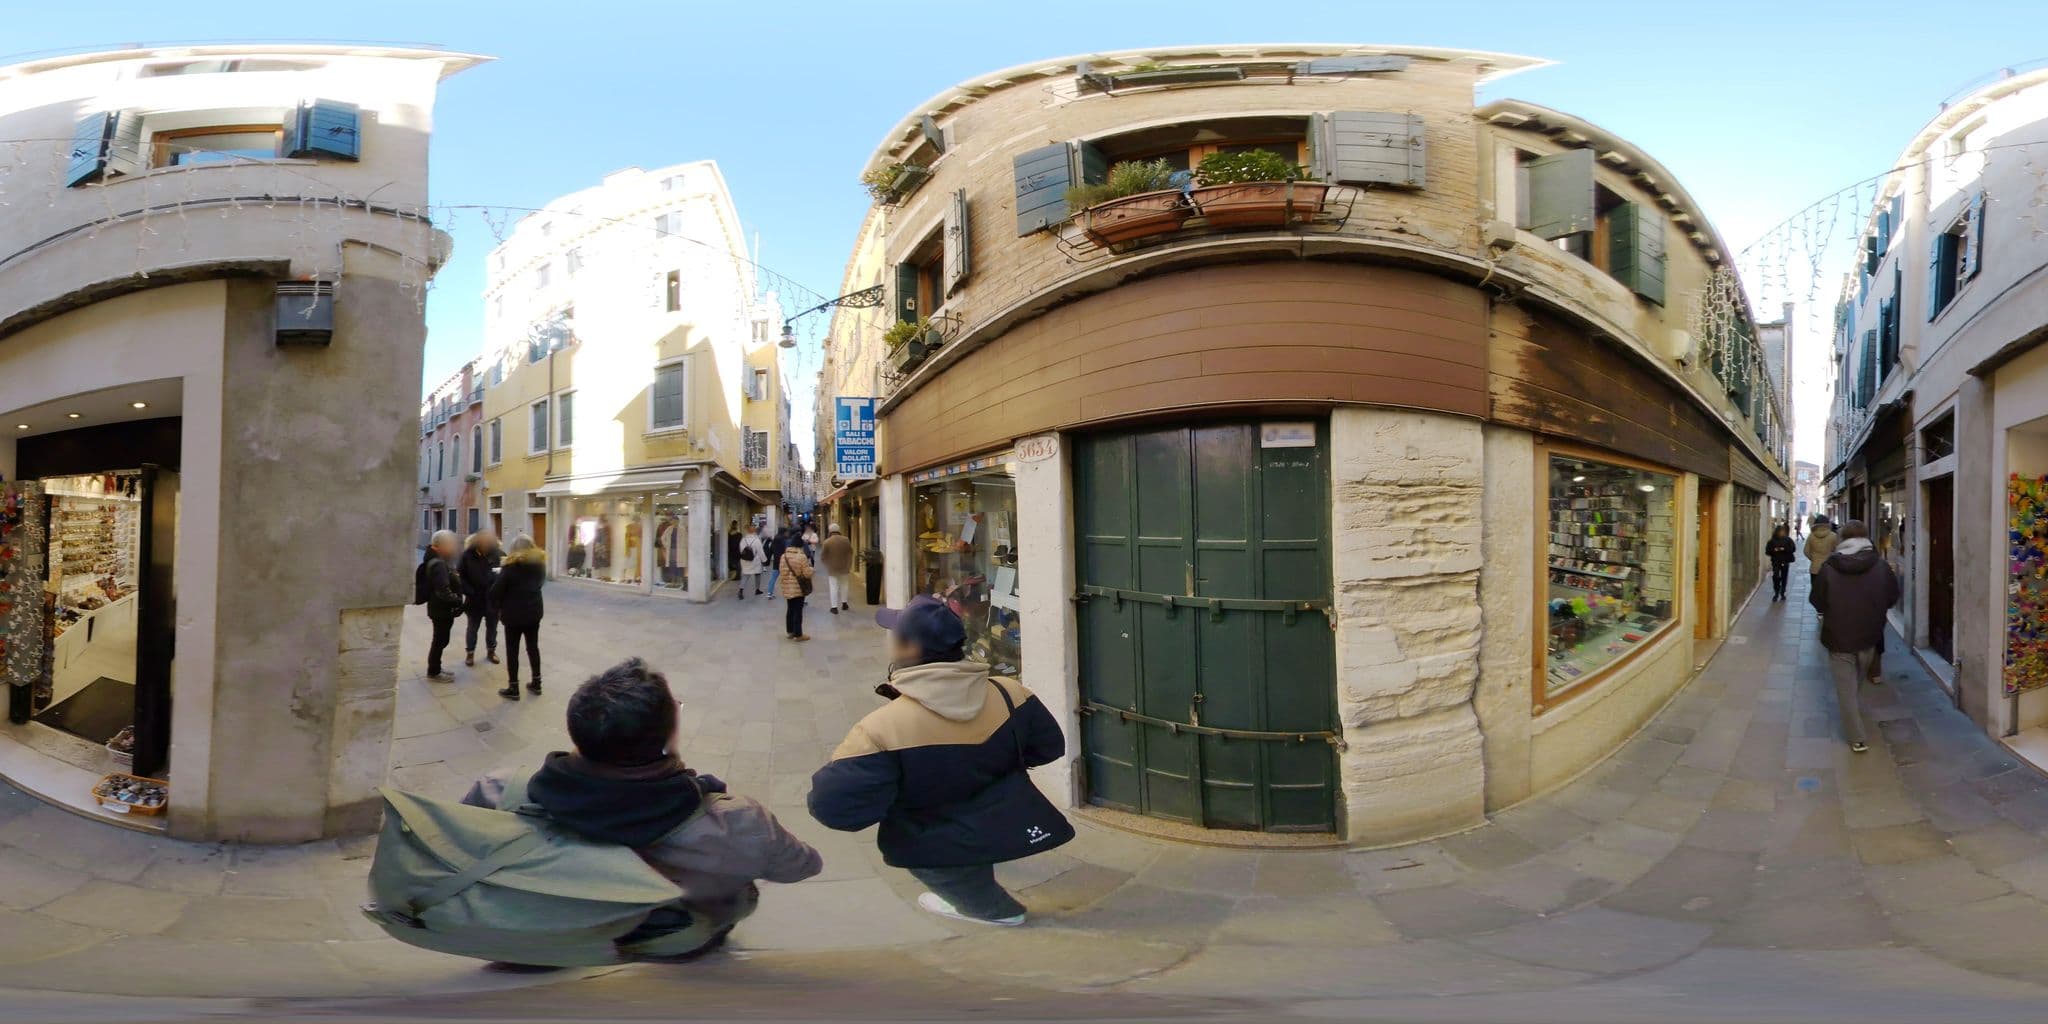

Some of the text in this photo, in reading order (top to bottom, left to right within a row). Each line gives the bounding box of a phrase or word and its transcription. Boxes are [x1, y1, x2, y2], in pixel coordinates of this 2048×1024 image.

[841, 399, 869, 430] T
[838, 437, 874, 446] TABACCHI
[839, 463, 873, 473] LOTTO
